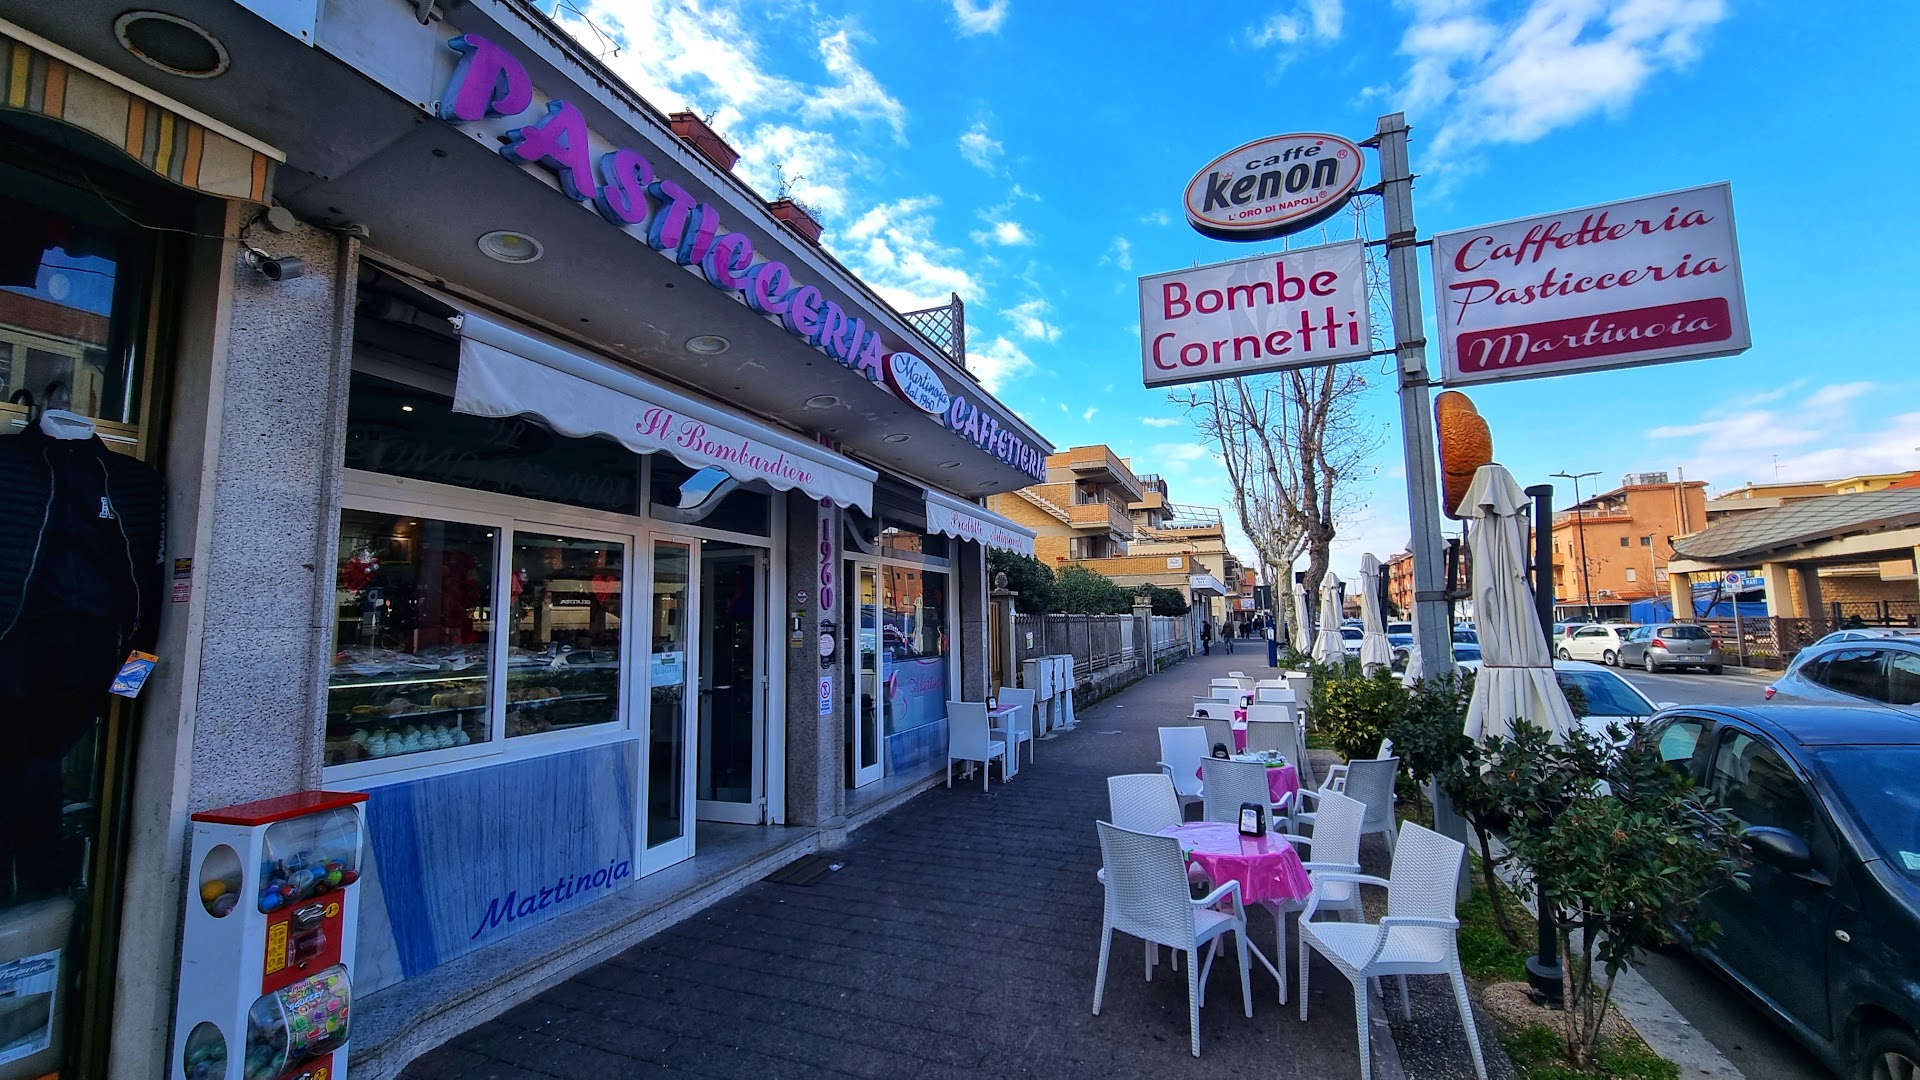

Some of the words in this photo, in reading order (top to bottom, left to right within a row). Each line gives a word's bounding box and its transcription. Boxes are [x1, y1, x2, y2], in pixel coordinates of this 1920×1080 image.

[438, 32, 885, 383] PASTICCERIA
[1202, 157, 1340, 213] kenon
[1239, 208, 1262, 219] ORO
[1265, 204, 1276, 213] DI
[1279, 196, 1319, 210] NAPOLI
[1454, 204, 1716, 274] Caffetteria
[1162, 261, 1338, 321] Bombe
[1449, 254, 1729, 327] Pasticceria
[1152, 306, 1361, 371] Cornetti
[1468, 311, 1720, 367] Martinoia
[904, 382, 919, 401] dal
[919, 393, 935, 412] 1960
[636, 407, 674, 441] Il
[676, 420, 816, 485] Bombardiere
[945, 396, 1047, 483] CAFFETTERIA
[820, 517, 834, 611] 1960
